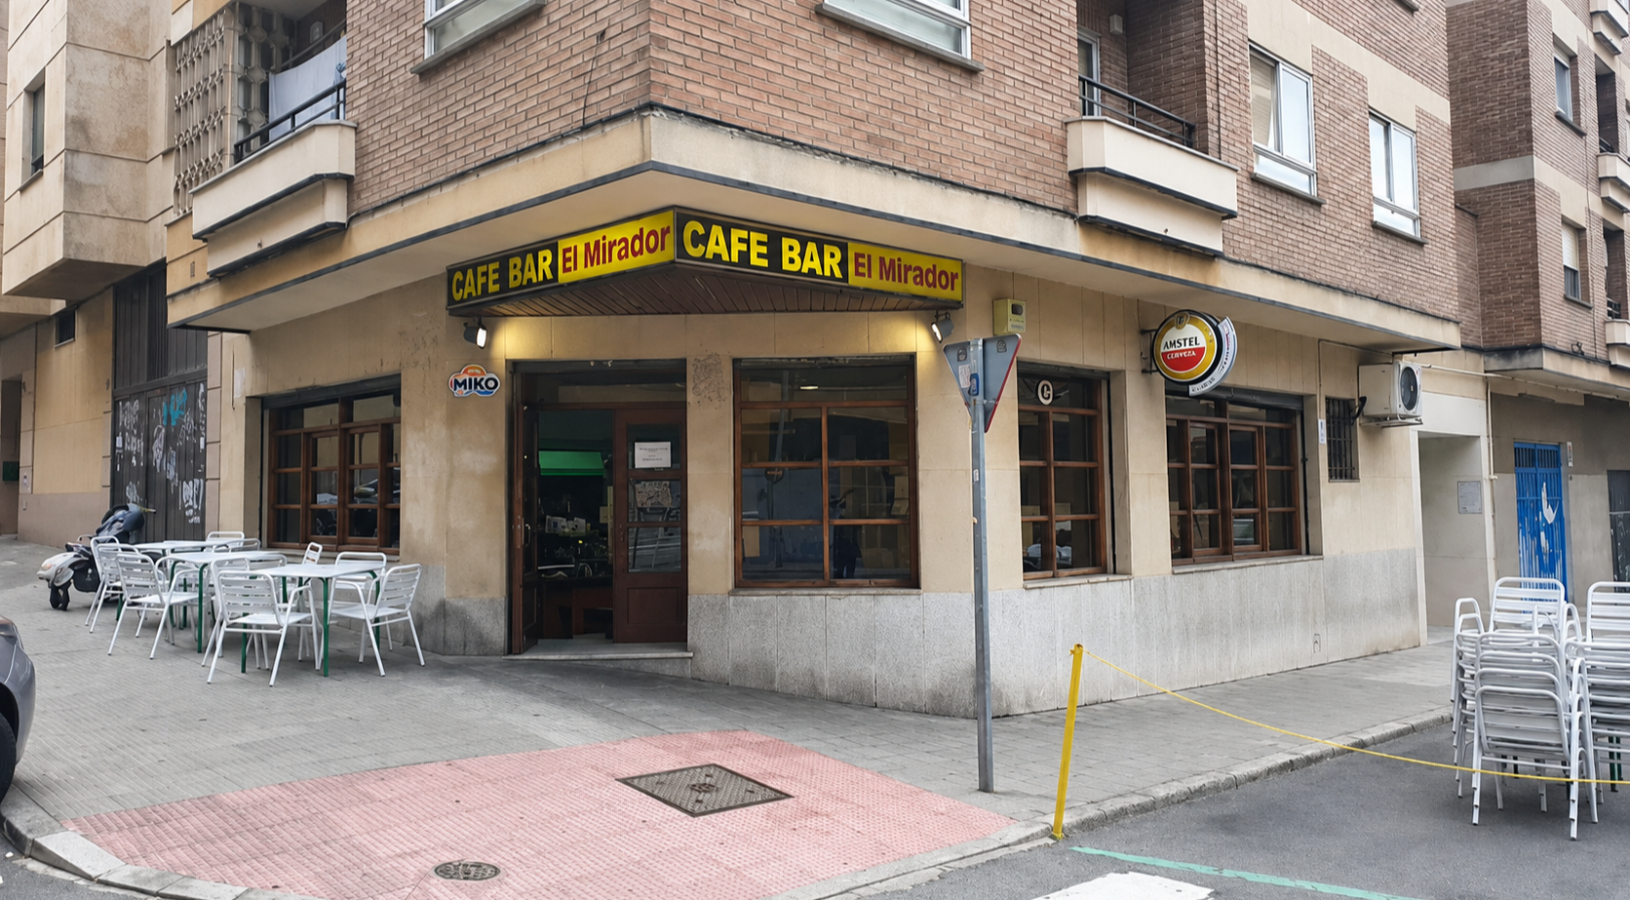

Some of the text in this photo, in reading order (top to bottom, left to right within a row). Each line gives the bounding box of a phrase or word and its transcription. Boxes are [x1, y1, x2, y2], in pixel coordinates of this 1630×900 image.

[452, 225, 671, 301] CAFE BAR El Mirador
[683, 220, 959, 291] CAFE BAR El Mirador
[1163, 336, 1200, 350] AMSTEL
[453, 376, 499, 391] MIKO
